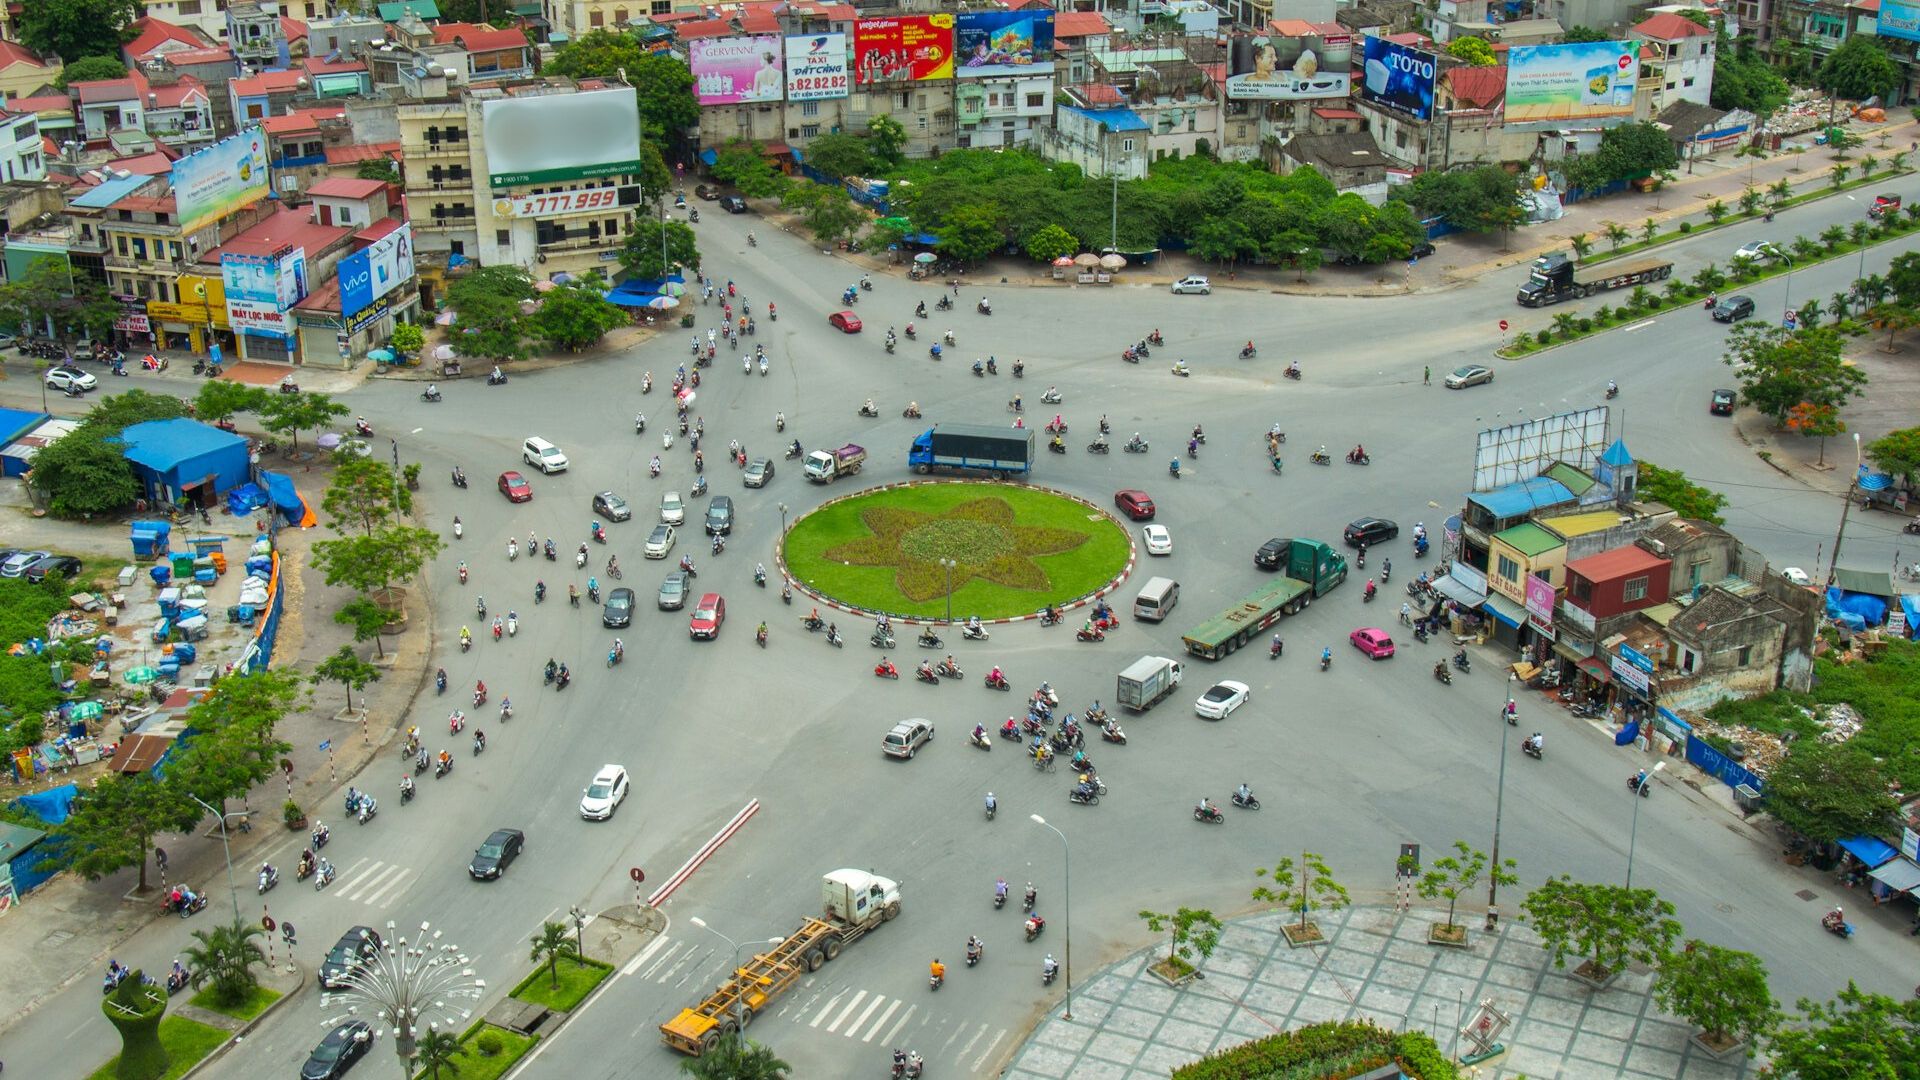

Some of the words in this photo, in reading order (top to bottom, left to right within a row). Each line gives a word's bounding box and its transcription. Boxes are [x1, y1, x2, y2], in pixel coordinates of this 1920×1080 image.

[705, 45, 757, 57] GERVENNE
[807, 56, 827, 64] TAXI
[1390, 52, 1433, 79] TOTO
[789, 76, 846, 91] 3.82.82.82
[582, 164, 637, 175] www.manulife.com.vn
[522, 190, 616, 214] 3.777.999
[343, 270, 369, 292] vivo
[232, 308, 247, 318] MÁY
[248, 311, 262, 321] LỌC
[263, 311, 283, 323] NƯỚC
